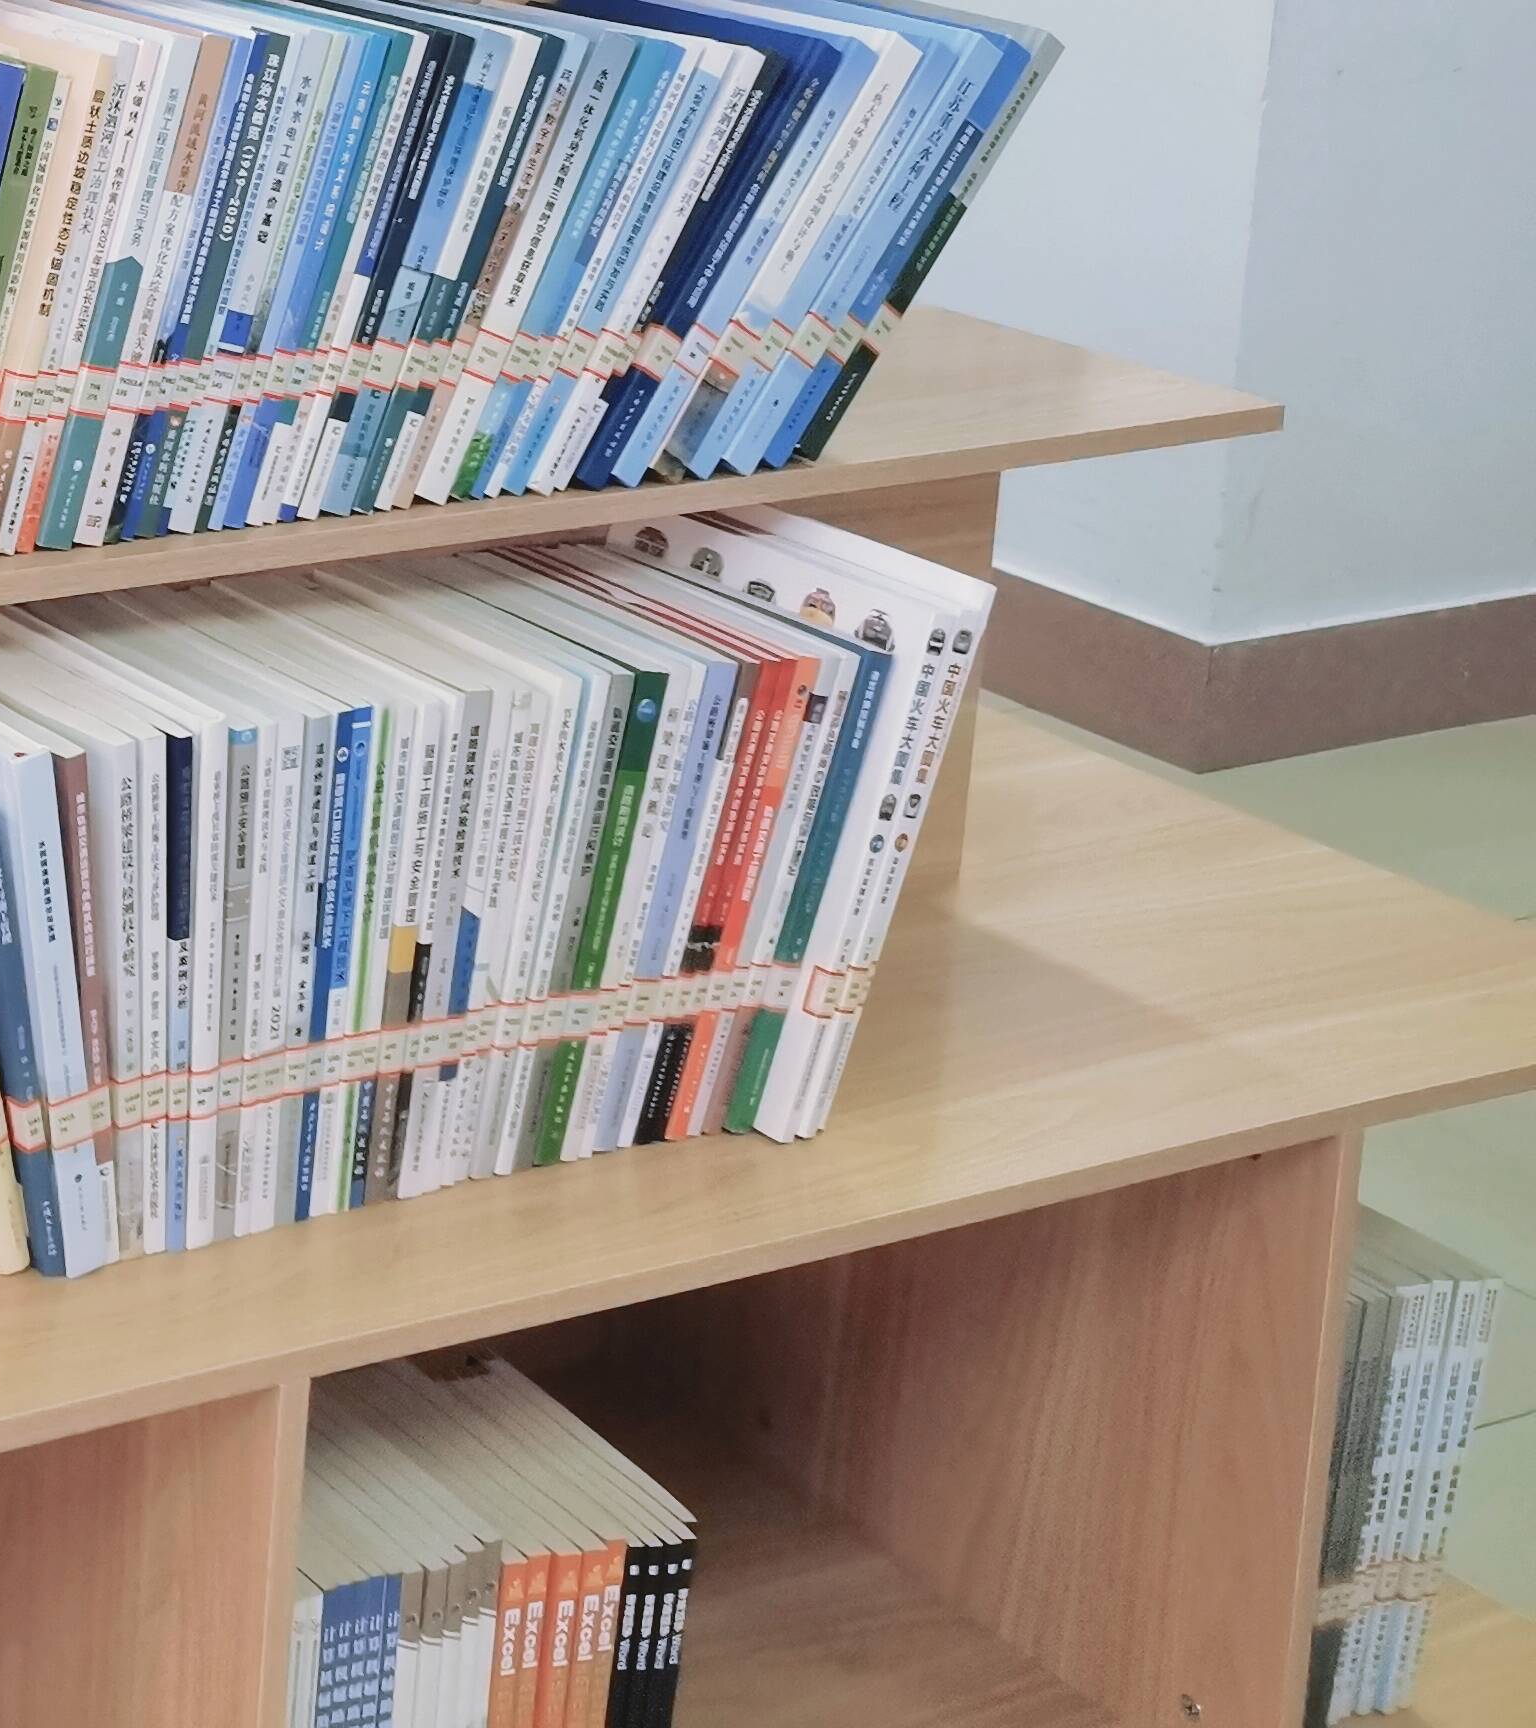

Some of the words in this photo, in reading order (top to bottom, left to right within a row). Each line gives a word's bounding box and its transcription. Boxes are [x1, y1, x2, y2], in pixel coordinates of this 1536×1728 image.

[500, 1608, 521, 1676] Excel
[522, 1601, 543, 1669] Excel
[552, 1600, 574, 1667] Excel
[577, 1594, 600, 1661] Excel
[597, 1584, 621, 1652] Excel
